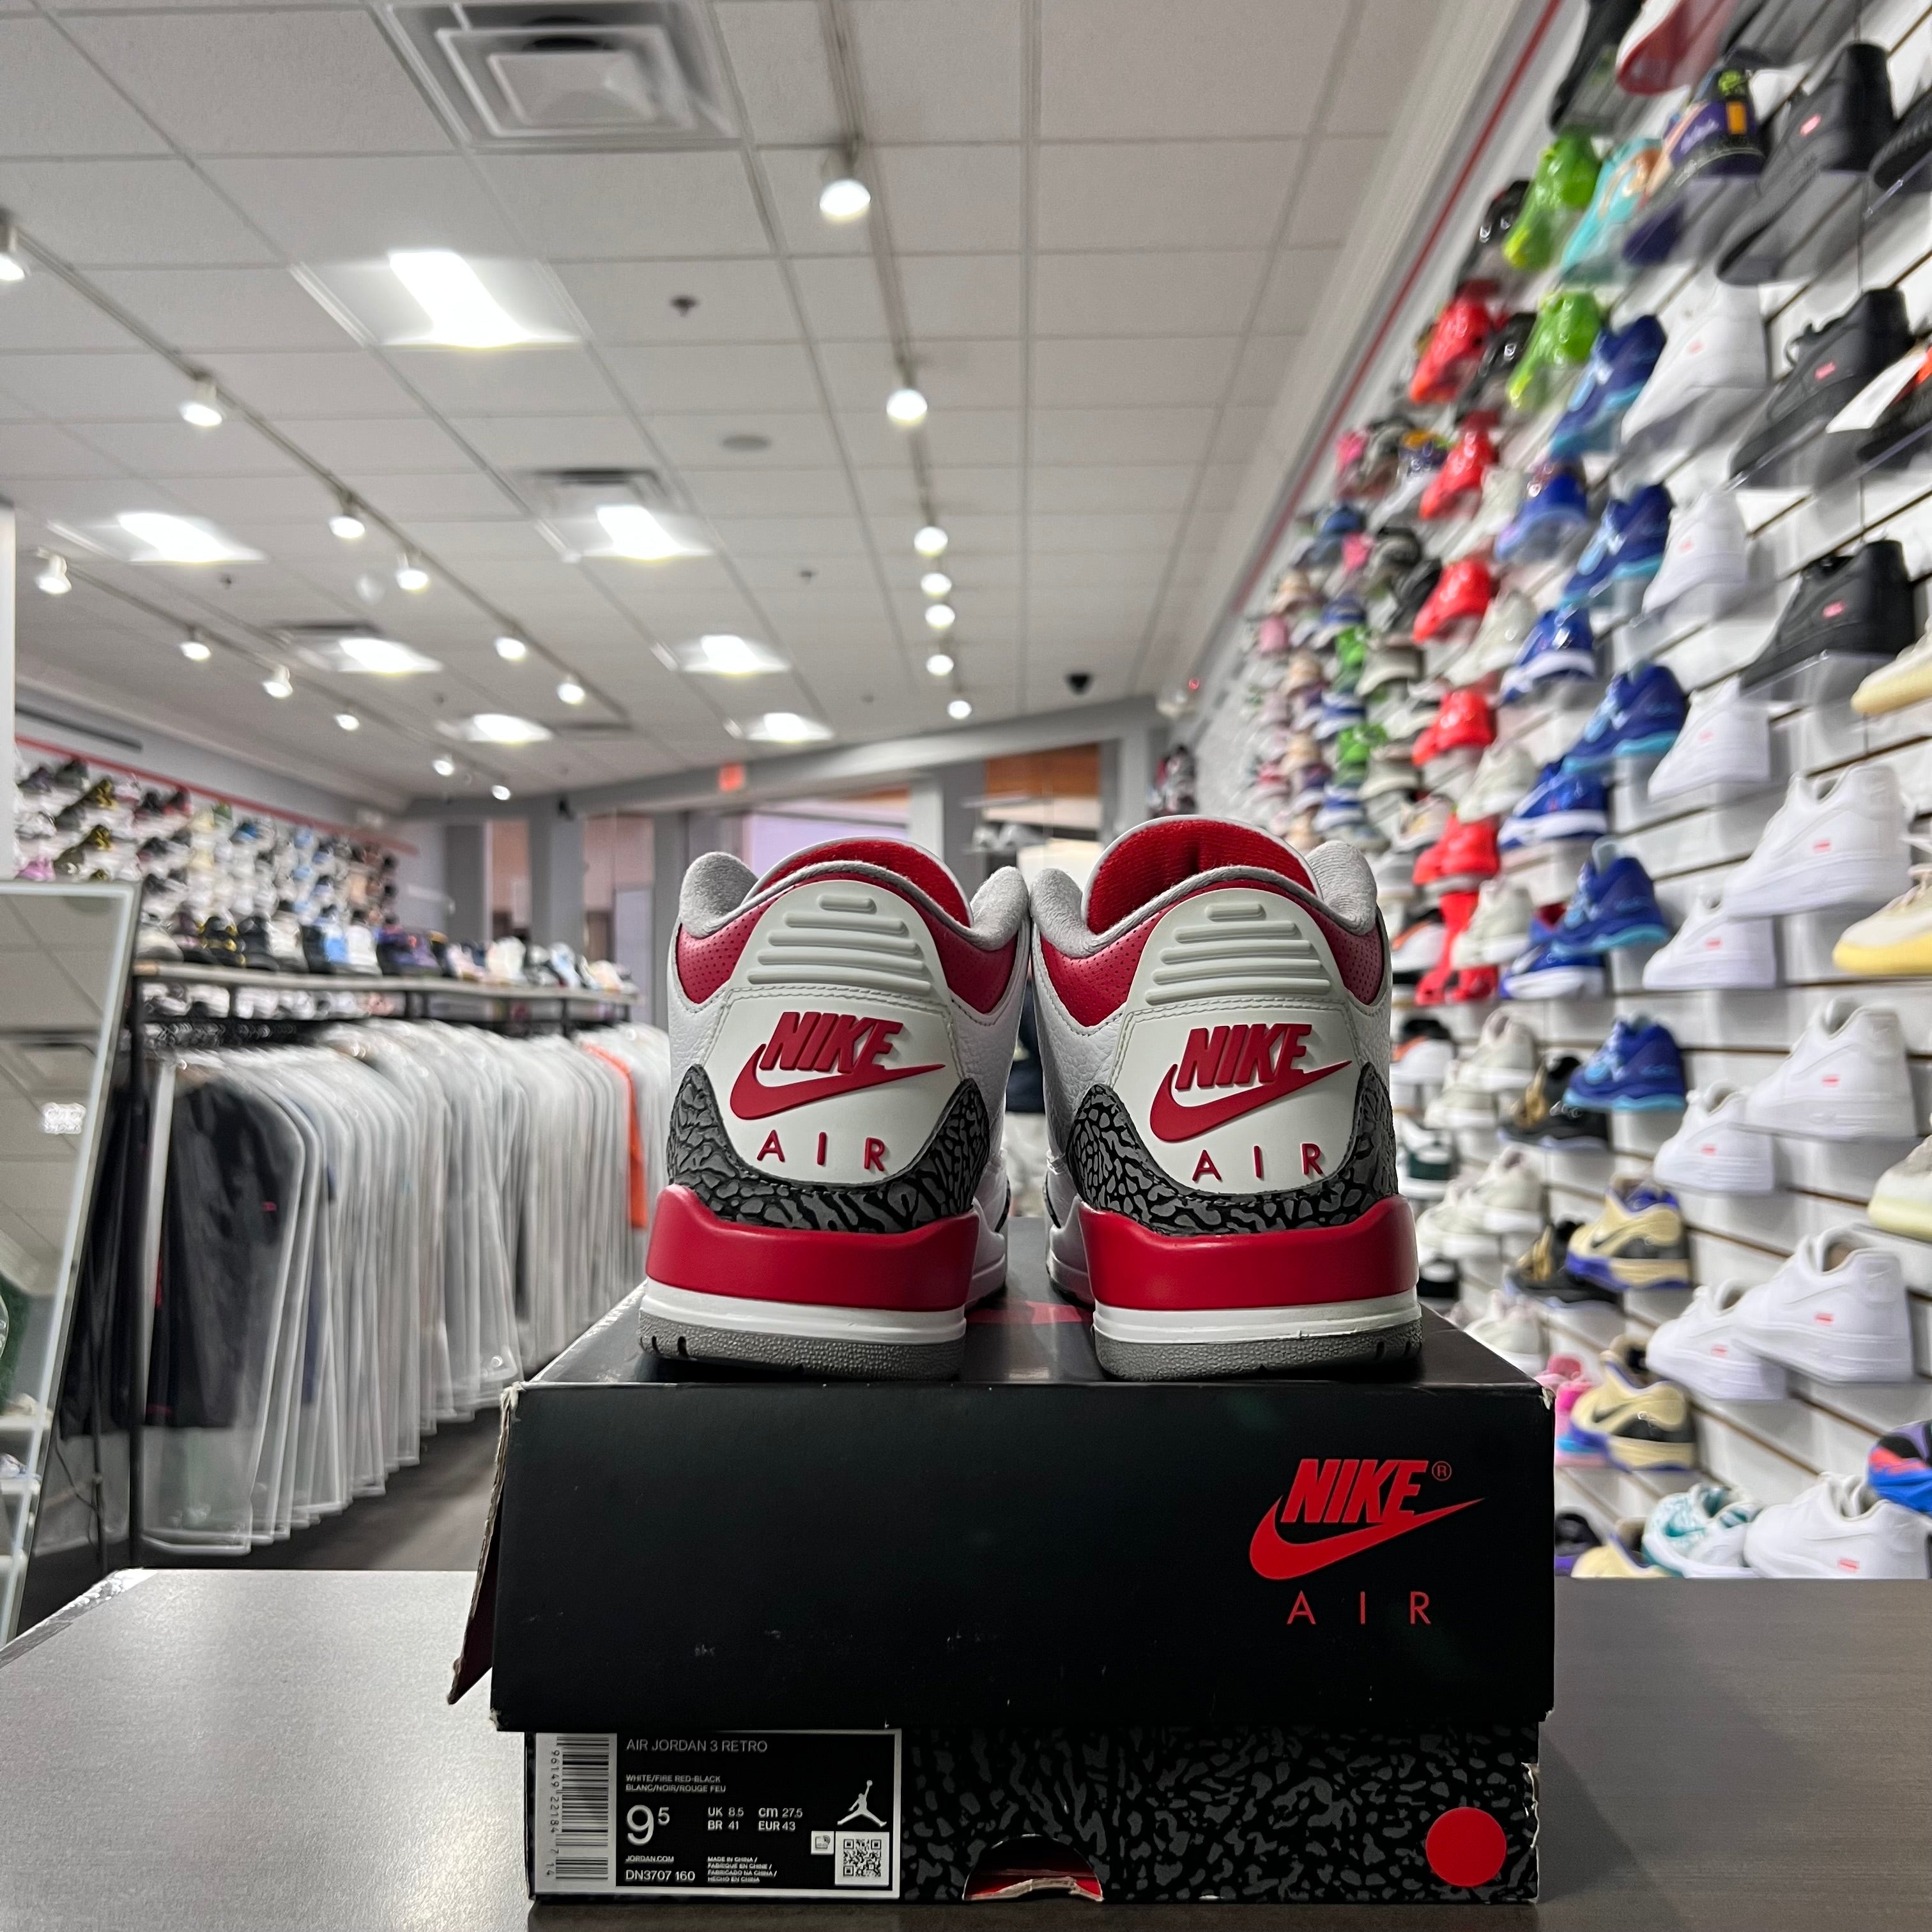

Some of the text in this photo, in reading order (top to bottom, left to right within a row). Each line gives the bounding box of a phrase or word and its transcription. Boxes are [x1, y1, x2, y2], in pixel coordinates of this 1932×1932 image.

[759, 1011, 903, 1074] NIKE
[1175, 1023, 1312, 1090] NIKE
[756, 1130, 885, 1172] AIR
[1192, 1143, 1323, 1181] AIR
[1280, 1459, 1429, 1523] NIKE
[1286, 1590, 1431, 1625] AIR
[625, 1738, 767, 1752] AIR JORDAN 3 RETRO
[625, 1774, 673, 1782] WHITE/FIRE
[625, 1784, 708, 1793] BLANC/NOIR/ROUGE
[708, 1807, 744, 1817] UK 8.5
[758, 1807, 803, 1818] cm 27.5
[708, 1820, 739, 1830] BR 41
[758, 1820, 796, 1832] EUR 43
[625, 1869, 696, 1882] DN3707 160
